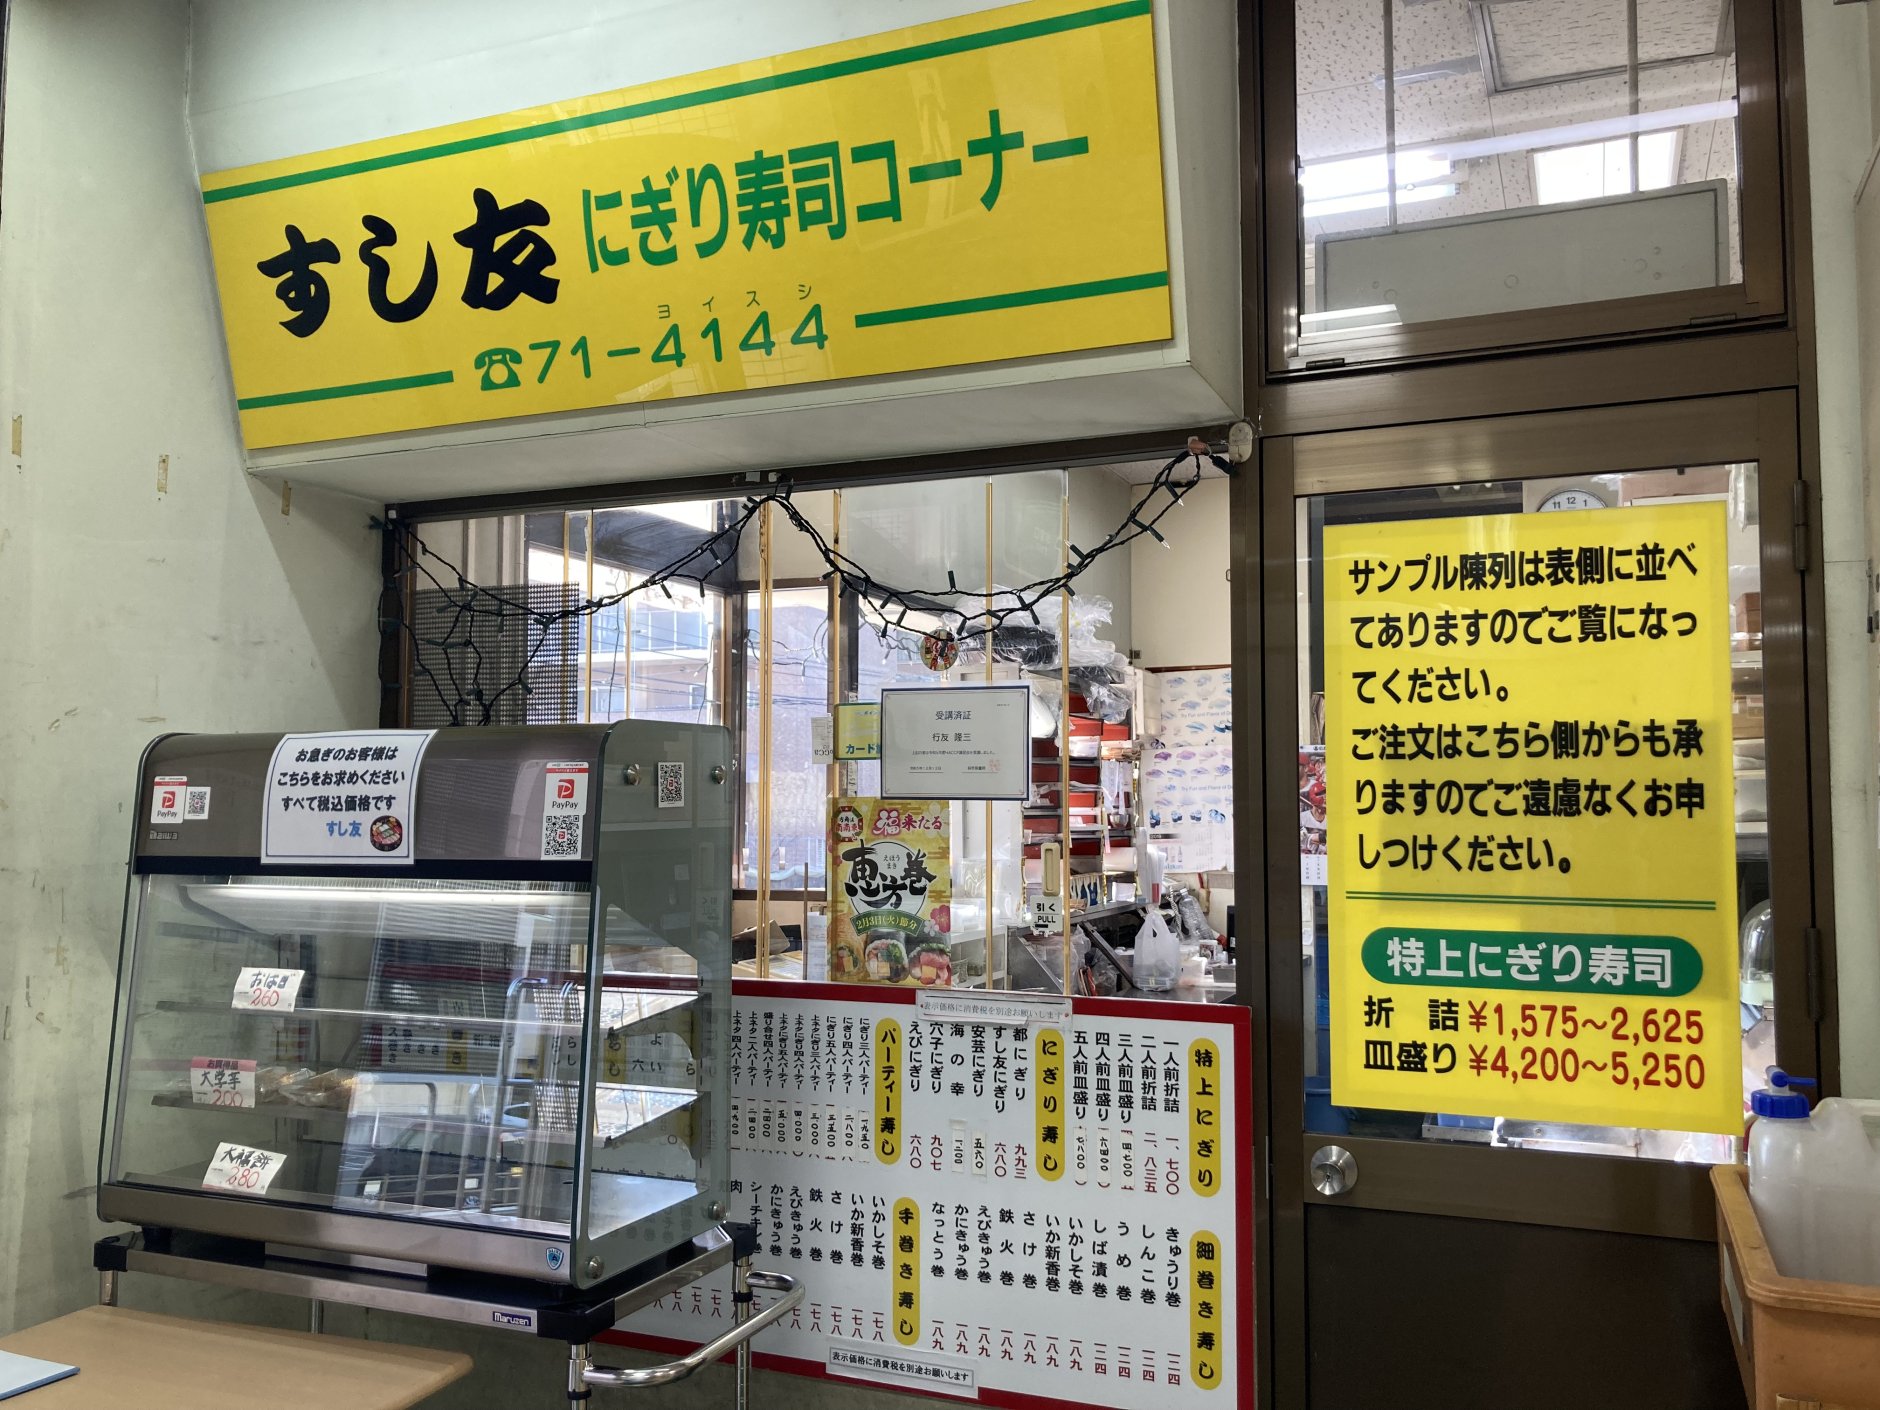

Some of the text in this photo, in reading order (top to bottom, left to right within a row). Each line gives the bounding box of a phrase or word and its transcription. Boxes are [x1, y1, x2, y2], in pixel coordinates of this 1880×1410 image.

[257, 109, 1090, 338] すし友 にぎり寿司コーナー
[527, 302, 830, 384] 71-4144
[1553, 501, 1560, 509] 11
[1348, 542, 1698, 595] サンプル陳列は表側に並べ
[1350, 602, 1698, 649] てありますのでご覧になっ
[935, 711, 972, 720] 受講済証
[1352, 666, 1509, 704] てください。
[295, 746, 399, 762] お急ぎのお客様は
[1351, 719, 1704, 760] ご注文はこちら側からも承
[157, 810, 177, 818] PayPay
[277, 769, 405, 786] こちらをお求めください
[282, 795, 396, 812] すべて税込価格です
[552, 801, 578, 810] PayPay
[1355, 778, 1705, 818] りますのでご遠慮なくお申
[326, 820, 362, 837] すし友
[872, 809, 942, 835] 福来たる
[1358, 834, 1571, 873] しつけください。
[842, 839, 937, 909] 恵方巻
[250, 987, 280, 1007] 260
[1386, 937, 1672, 989] 特上にぎり寿司
[880, 1028, 896, 1156] パーティー寿し
[908, 1020, 923, 1092] えびにぎり
[929, 1022, 944, 1094] 穴子にぎり
[950, 1023, 965, 1096] 海の幸
[971, 1024, 986, 1097] 安芸にぎり
[992, 1026, 1007, 1113] すし友にぎり
[1072, 1030, 1089, 1120] 五人前皿盛り
[1095, 1032, 1111, 1122] 四人前皿盛り
[1117, 1033, 1134, 1124] 三人前皿盛り
[1140, 1036, 1157, 1112] 二人前折詰
[1163, 1041, 1180, 1113] 一人前折詰
[1363, 1040, 1458, 1075] 皿盛り
[211, 1088, 243, 1107] 200
[1012, 1027, 1028, 1179] 都にぎり 九九三
[1041, 1039, 1059, 1172] にぎり寿し
[1194, 1048, 1214, 1187] 特上にぎり
[225, 1166, 260, 1188] 280
[770, 1183, 784, 1257] かにきゅう巻
[789, 1186, 803, 1259] えびきゅう巻
[809, 1188, 823, 1262] 鉄火巻
[830, 1190, 843, 1264] さけ巻
[850, 1193, 864, 1267] いか新香巻
[871, 1195, 886, 1270] いかしそ巻
[930, 1201, 945, 1277] なっとう巻
[954, 1204, 969, 1281] かにきゅう巻
[977, 1205, 992, 1284] えびきゅう巻
[999, 1208, 1014, 1286] 鉄火巻
[1022, 1211, 1037, 1290] さけ巻
[1044, 1214, 1060, 1292] いか新香巻
[1068, 1216, 1084, 1295] いかしそ巻
[899, 1208, 914, 1337] 手巻き寿し
[1092, 1219, 1108, 1298] しば漬巻
[1116, 1221, 1132, 1302] うめ巻
[1140, 1224, 1156, 1304] しんこ巻
[1165, 1227, 1182, 1308] きゅうり巻
[494, 1312, 529, 1326] Maruzen
[1197, 1240, 1215, 1380] 細巻き寿し
[832, 1351, 969, 1382] 表示価格に消費税を別途お願いします
